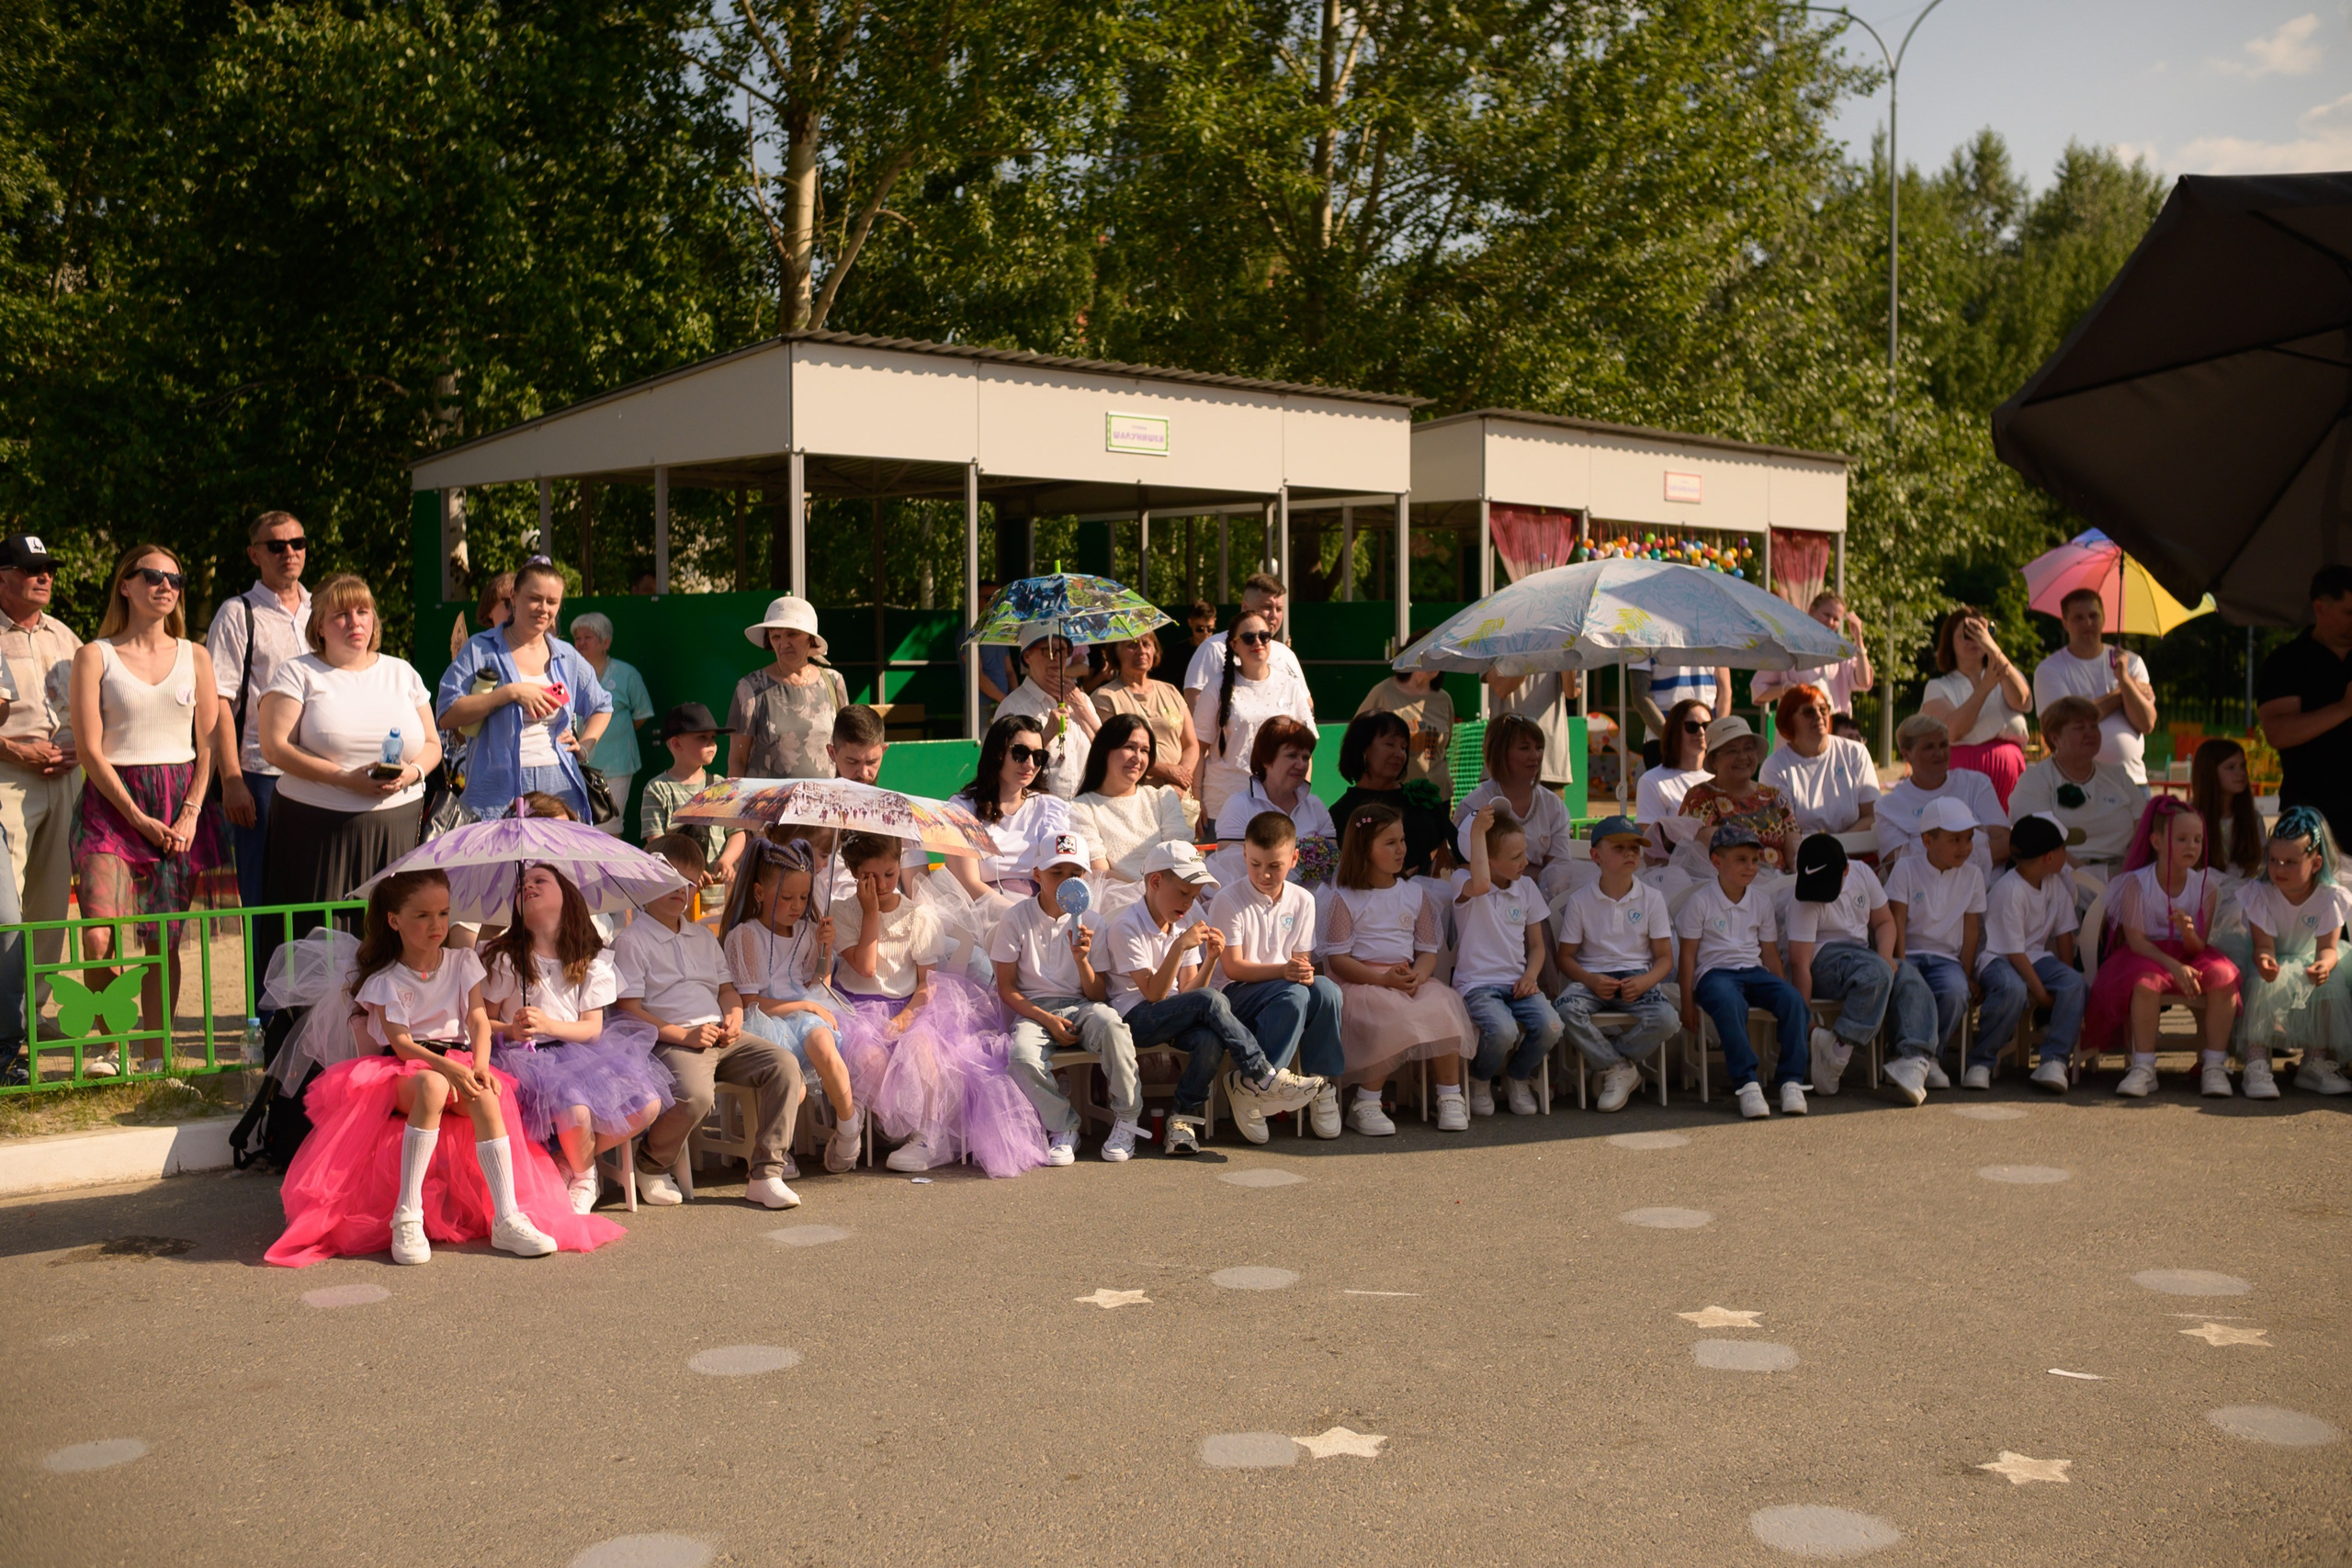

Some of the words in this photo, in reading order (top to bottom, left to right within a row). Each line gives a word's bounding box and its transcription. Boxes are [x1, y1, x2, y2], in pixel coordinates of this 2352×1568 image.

[1113, 431, 1164, 443] ШАЛУНИШКИ
[1633, 912, 1641, 920] Я
[1284, 917, 1293, 925] Я
[404, 991, 413, 1002] Я
